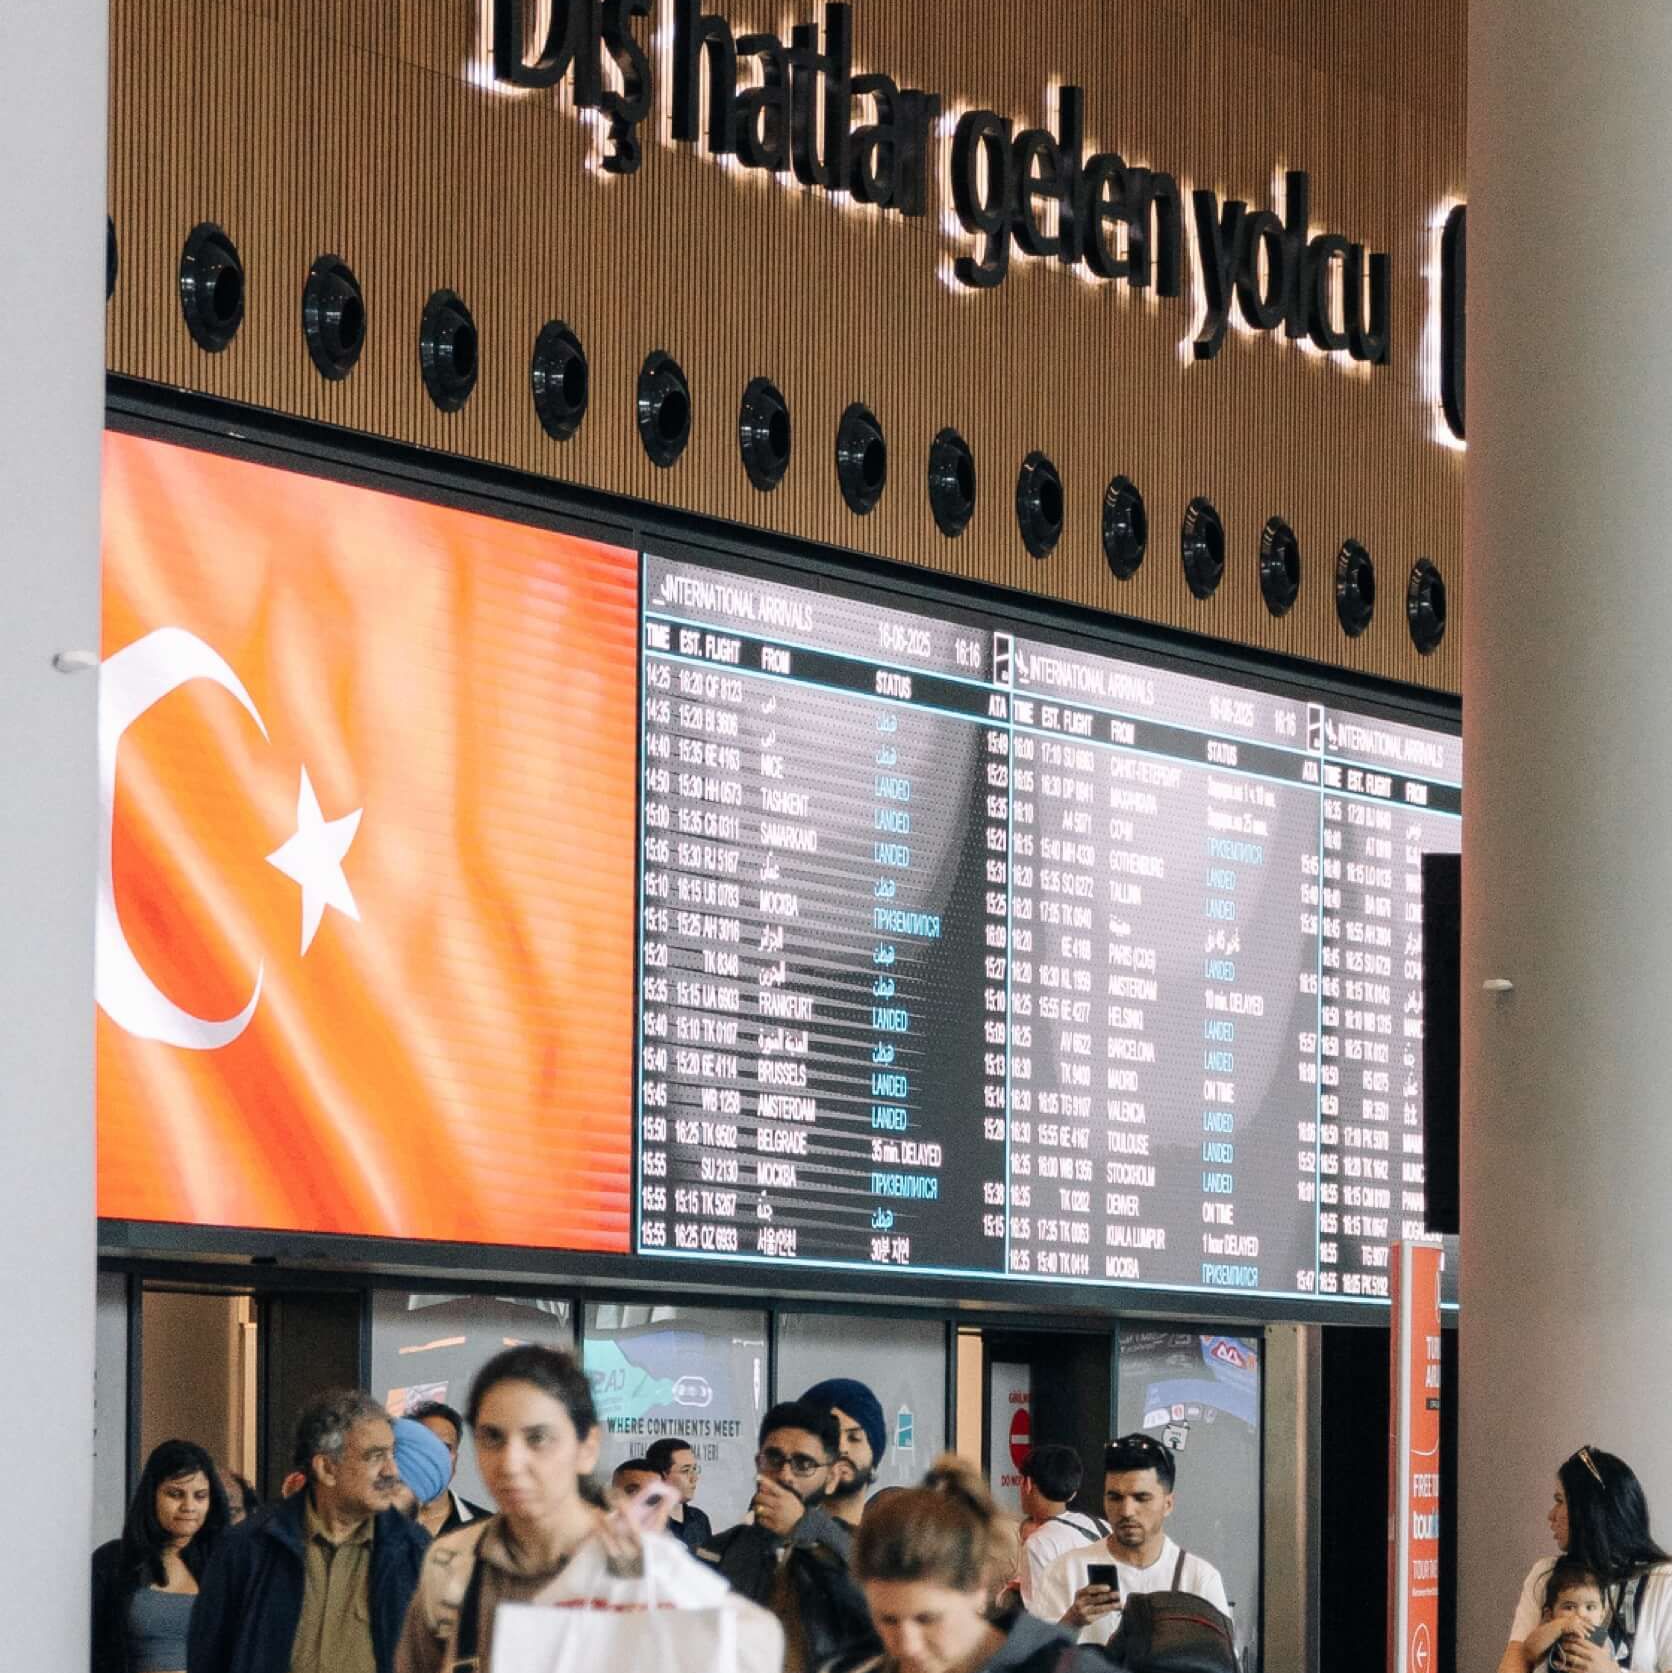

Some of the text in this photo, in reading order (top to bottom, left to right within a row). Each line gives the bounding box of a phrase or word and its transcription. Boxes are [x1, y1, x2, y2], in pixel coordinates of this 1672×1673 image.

[949, 85, 1181, 298] gelen
[1190, 171, 1391, 365] yolcu
[666, 573, 980, 668] INTERNATIONAL ARRIVALS 16-06-2025 16:16
[646, 621, 1006, 719] TIME EST. FLIGHT FROM STATUS ATA
[646, 662, 703, 696] 14:25 16:20
[1029, 652, 1153, 706] INTERNATIONAL ARRIVALS
[646, 697, 670, 724] 14:35
[678, 703, 703, 730] 15:20
[1013, 697, 1319, 783] TIME EST. FLIGHT FROM STATUS ATA
[1338, 723, 1444, 768] INTERNATIONAL ARRIVALS
[646, 732, 910, 801] 14:40 15:35 NICE LANDED
[1347, 769, 1427, 805] EST. FLIGHT FROM
[645, 766, 1007, 850] 14:50 15:30 HH TASHKENT LANDED 15:21
[645, 801, 1007, 882] 15:00 15:35 0311 SAMARKAND LANDED 15:31
[645, 836, 669, 863] 15:05
[677, 841, 701, 868] 15:30
[704, 845, 716, 870] RJ
[1109, 848, 1163, 879] GOTHENBURG
[1206, 866, 1235, 892] LANDED
[644, 871, 738, 908] 15:10 16:15 U6 0783
[759, 888, 798, 916] МОСКВА
[873, 905, 940, 937] ПРИЗЕМЛИЛСЯ
[1205, 897, 1235, 922] LANDED
[644, 906, 1006, 978] 15:15 15:25 AH 3016 15:27
[1108, 942, 1132, 966] PARIS
[644, 941, 1006, 1010] 15:20 TK 15:10
[1205, 958, 1234, 982] LANDED
[643, 976, 667, 1002] 15:35
[675, 980, 700, 1006] 15:15
[702, 983, 716, 1008] UA
[759, 990, 813, 1019] FRANKFURT
[872, 1005, 908, 1031] LANDED
[1108, 974, 1264, 1017] AMSTERDAM DELAYED
[1108, 1005, 1234, 1043] LANDED HELSINKI
[643, 1011, 1005, 1075] 15:40 15:10 TK 0107 15:13
[1108, 1036, 1234, 1073] LANDED BARCELONA
[643, 1046, 666, 1072] 15:40
[675, 1050, 699, 1075] 15:20
[715, 1054, 737, 1079] 4114
[757, 1059, 806, 1086] BRUSSELS
[872, 1071, 908, 1097] LANDED
[984, 1083, 1005, 1107] 15:14
[1107, 1067, 1234, 1103] MADRID ON TIME
[642, 1081, 907, 1130] 15:45 WB AMSTERDAM LANDED
[1107, 1098, 1233, 1133] LANDED VALENCIA
[642, 1116, 941, 1166] 15:50 16:25 TK BELGRADE 35 min. DELAYED
[1107, 1130, 1233, 1163] LANDED TOULOUSE
[642, 1151, 738, 1182] 15:55 SU 2130
[757, 1161, 796, 1187] МОСКВА
[871, 1171, 938, 1198] ПРИЗЕМЛИЛСЯ
[1107, 1161, 1233, 1193] LANDED STOCKHOLM
[641, 1186, 1004, 1236] 15:55 15:15 TK 15:15
[1106, 1192, 1233, 1224] DENVER ON TIME
[641, 1222, 714, 1250] 15:55 16:25 OZ
[1106, 1223, 1259, 1256] KUALA LUMPUR DELAYED
[607, 1416, 741, 1437] WHERE CONTINENTS MEET
